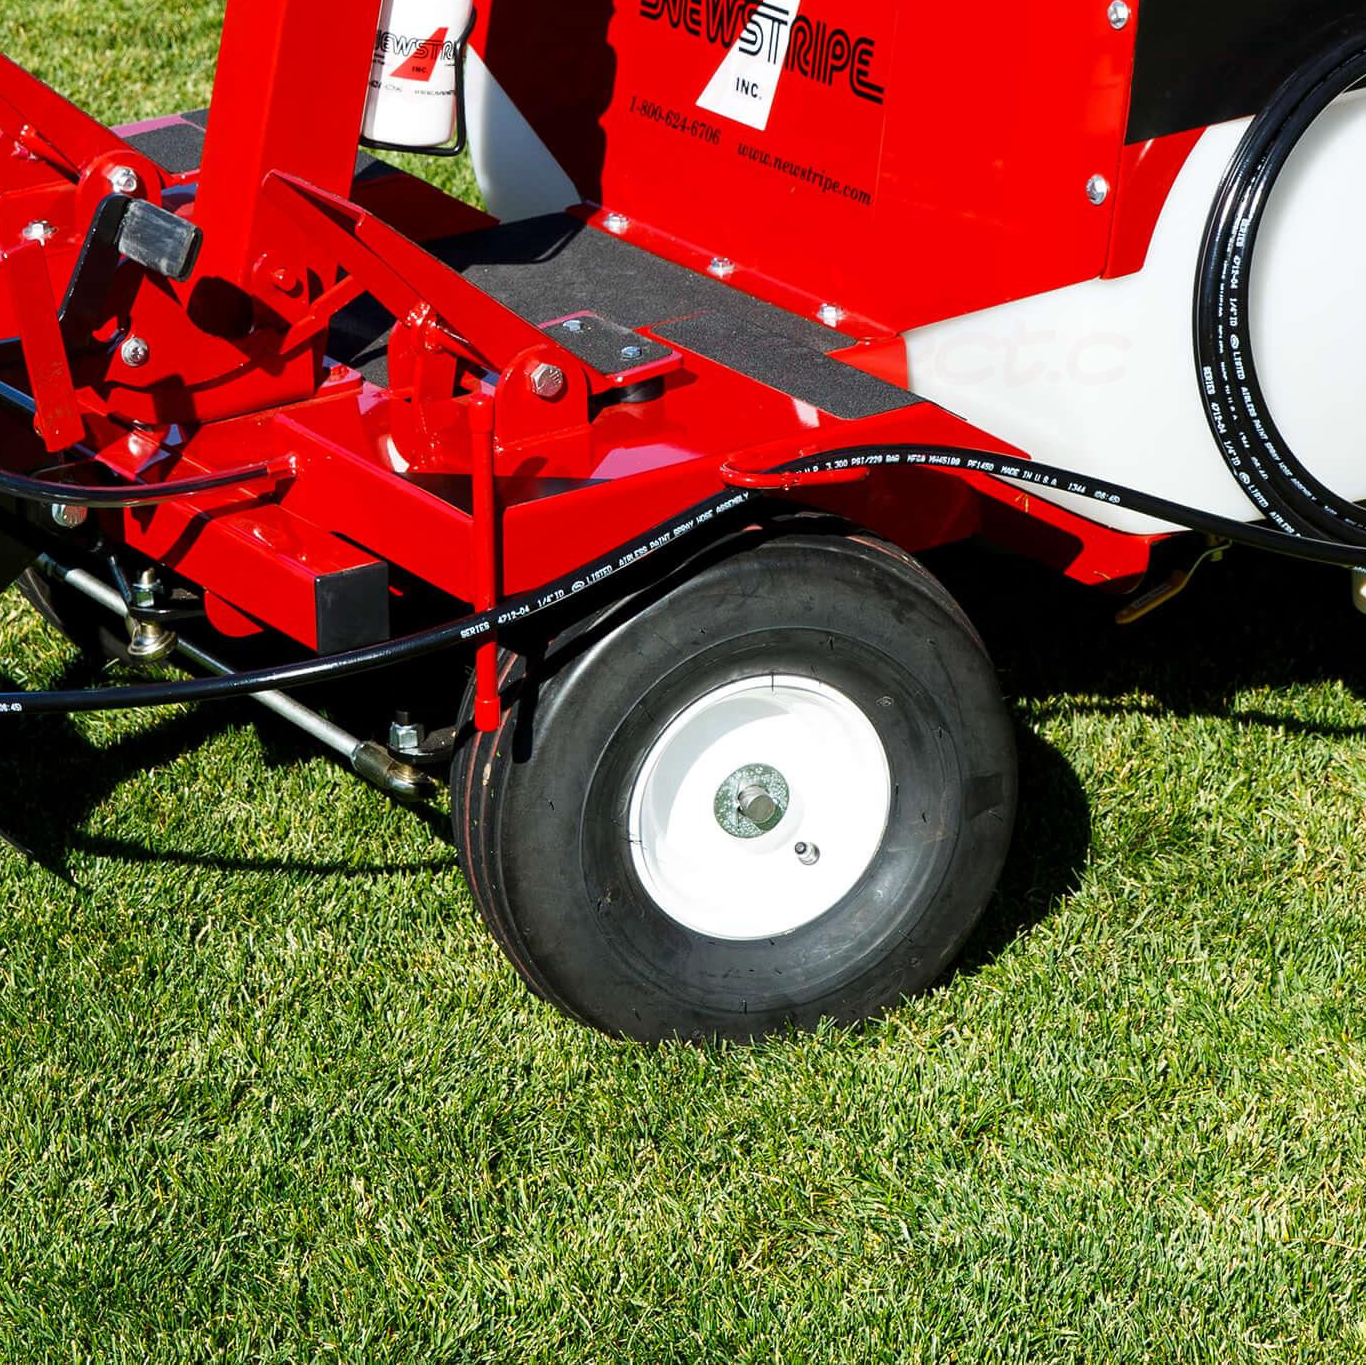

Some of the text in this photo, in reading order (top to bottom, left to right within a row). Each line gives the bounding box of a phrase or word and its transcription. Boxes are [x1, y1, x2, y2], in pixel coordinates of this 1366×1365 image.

[735, 77, 763, 101] INC.
[629, 96, 872, 206] 1-800-624-6706 www.newstripe.com
[1211, 402, 1227, 434] 4712-04
[460, 621, 491, 639] SERIES
[497, 604, 530, 624] 4712-04
[585, 564, 613, 584] LISTED
[618, 545, 648, 567] AIRLESS
[649, 532, 670, 549] PAINT
[673, 520, 694, 536] SPRAY
[696, 508, 713, 523] HOSE
[716, 491, 749, 513] ASSEMBLY
[1000, 465, 1020, 477] MADE
[1022, 470, 1033, 480] IN
[1067, 481, 1086, 494] 1344
